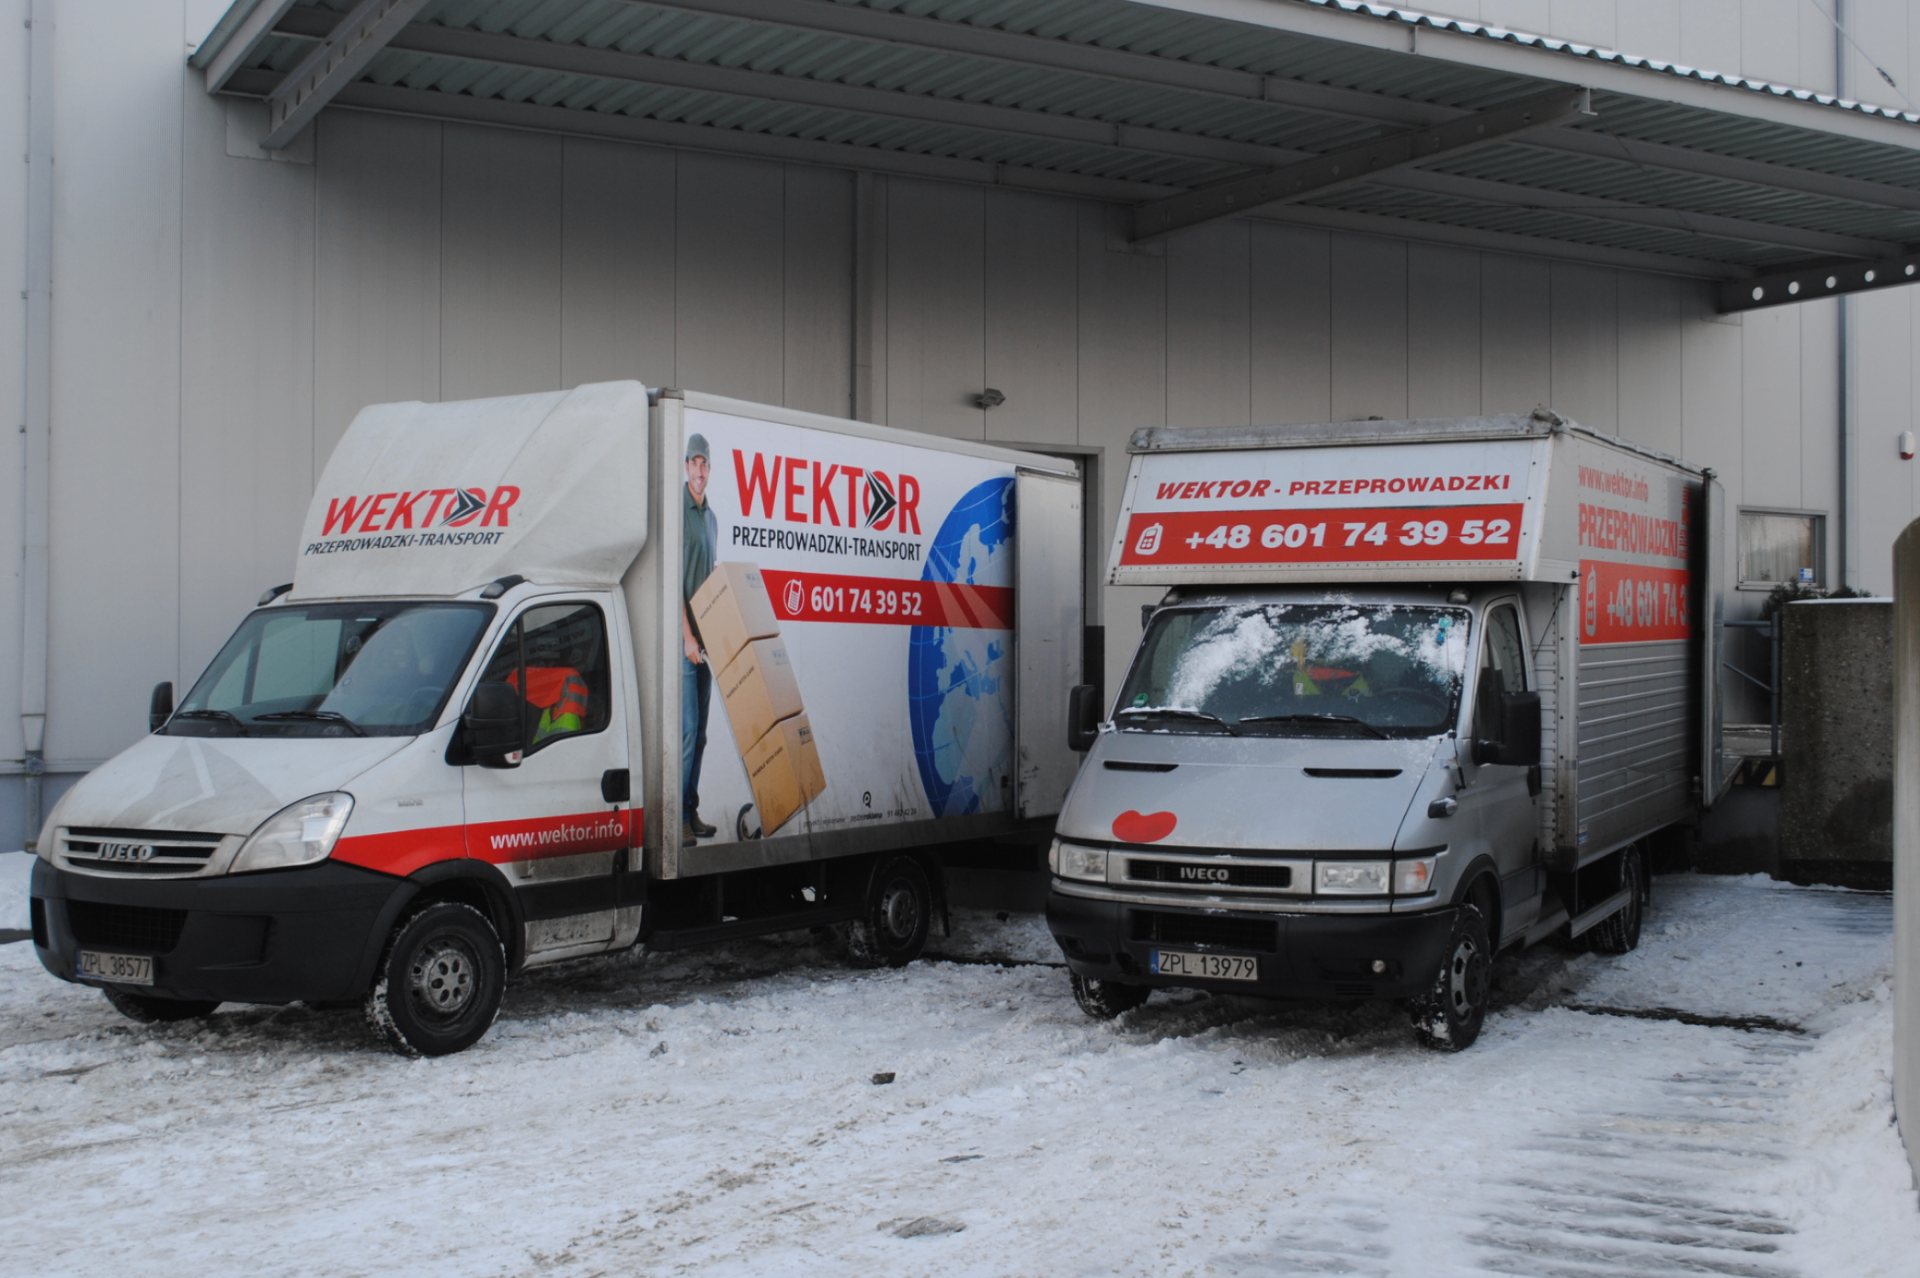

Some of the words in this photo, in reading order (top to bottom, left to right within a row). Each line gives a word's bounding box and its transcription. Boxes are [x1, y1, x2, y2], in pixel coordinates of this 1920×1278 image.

[732, 449, 922, 536] WEKTOR
[1155, 479, 1271, 499] WEKTOR
[1288, 475, 1510, 496] PRZEPROWADZKI
[1578, 465, 1649, 503] www.wektor.info
[321, 485, 520, 536] WEKTOR
[304, 532, 504, 556] PRZEPROWADZKI-TRANSPORT
[732, 526, 921, 562] PRZEPROWADZKI-TRANSPORT
[1185, 524, 1251, 550] +48
[1261, 522, 1325, 549] 601
[1342, 521, 1388, 547] 74
[1400, 519, 1449, 546] 39
[1459, 518, 1511, 545] 52
[1578, 502, 1679, 557] PRZEPROWADZKI
[811, 585, 844, 613] 601
[849, 587, 872, 614] 74
[876, 590, 897, 615] 39
[901, 592, 922, 617] 52
[1607, 578, 1633, 627] +48
[1637, 580, 1659, 627] 601
[1664, 582, 1677, 626] 74
[490, 819, 623, 849] www.wektor.info
[99, 842, 153, 861] IVECO
[1180, 866, 1228, 881] IVECO
[82, 953, 106, 975] ZPL
[110, 956, 151, 978] 38577
[1160, 953, 1192, 974] ZPL
[1200, 955, 1255, 978] 13979
